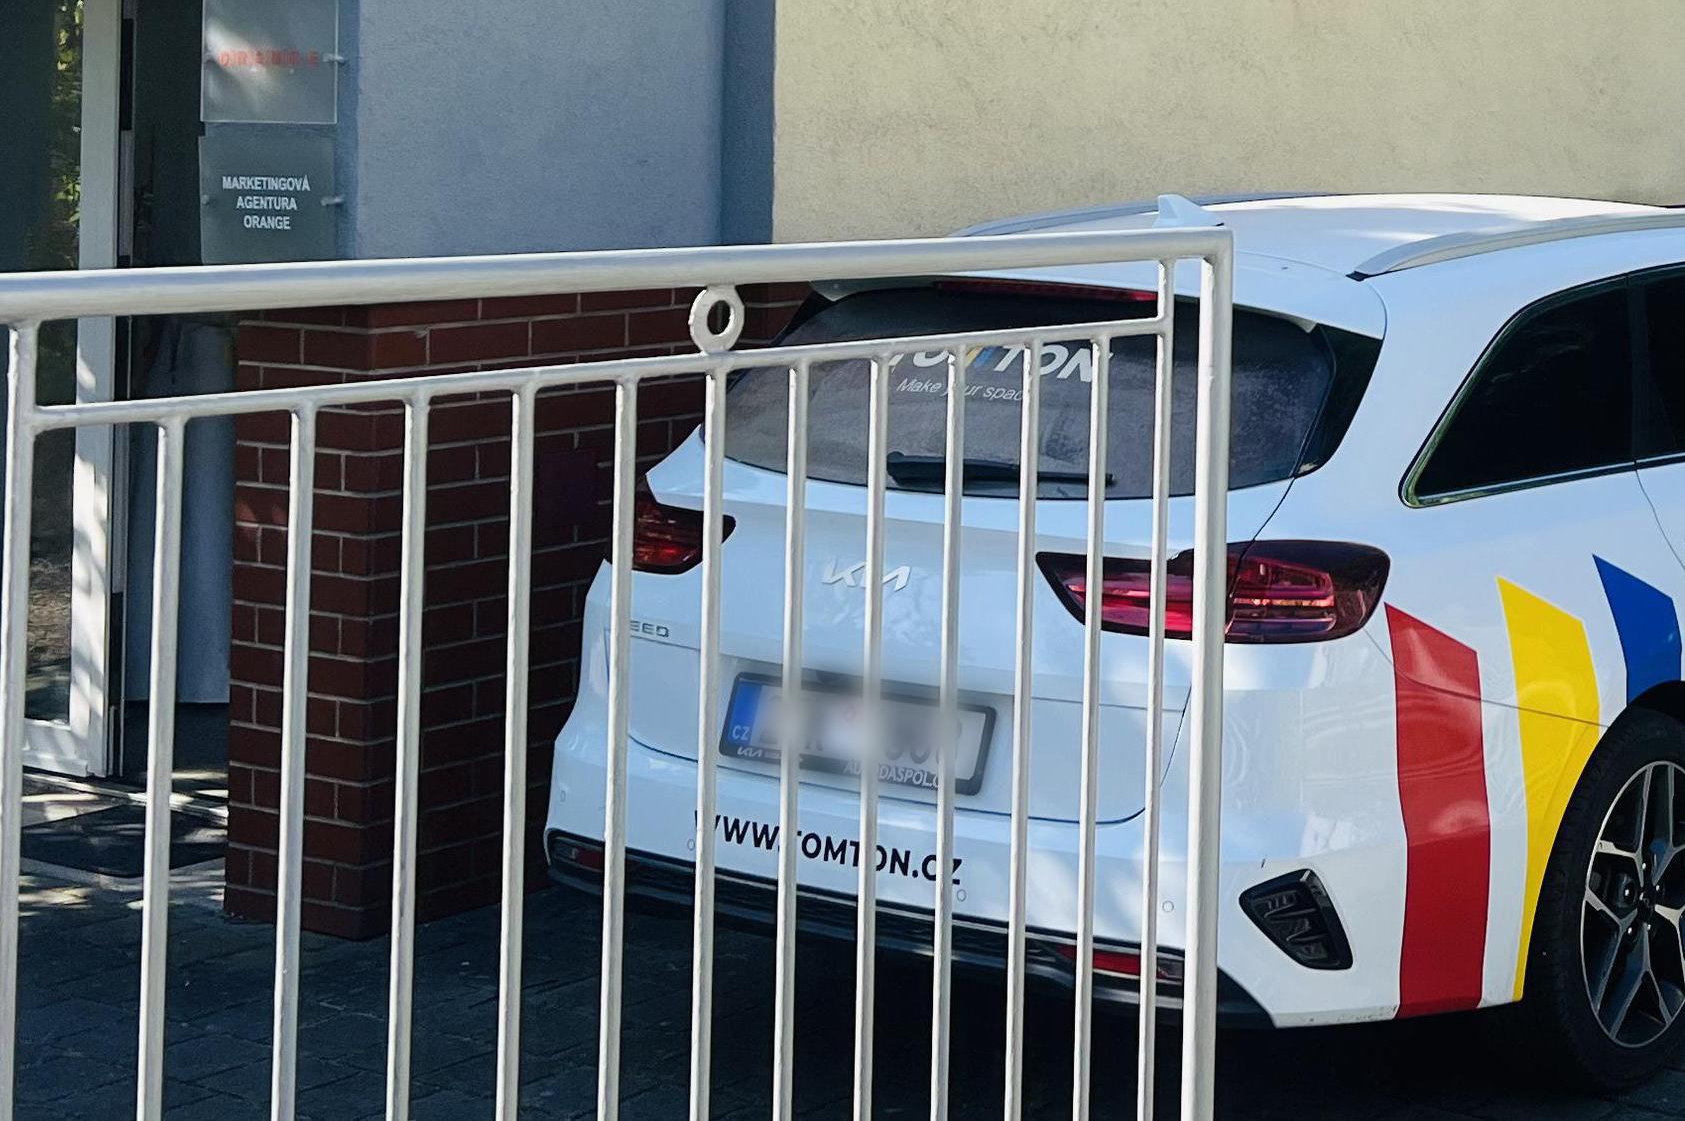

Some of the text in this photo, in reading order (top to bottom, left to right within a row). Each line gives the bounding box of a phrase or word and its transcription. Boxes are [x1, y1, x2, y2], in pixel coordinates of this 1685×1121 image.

[222, 175, 311, 191] MARKETINGOVÁ
[236, 196, 298, 210] AGENTURA
[243, 215, 291, 229] ORANGE
[896, 378, 942, 393] Make
[731, 724, 750, 741] CZ
